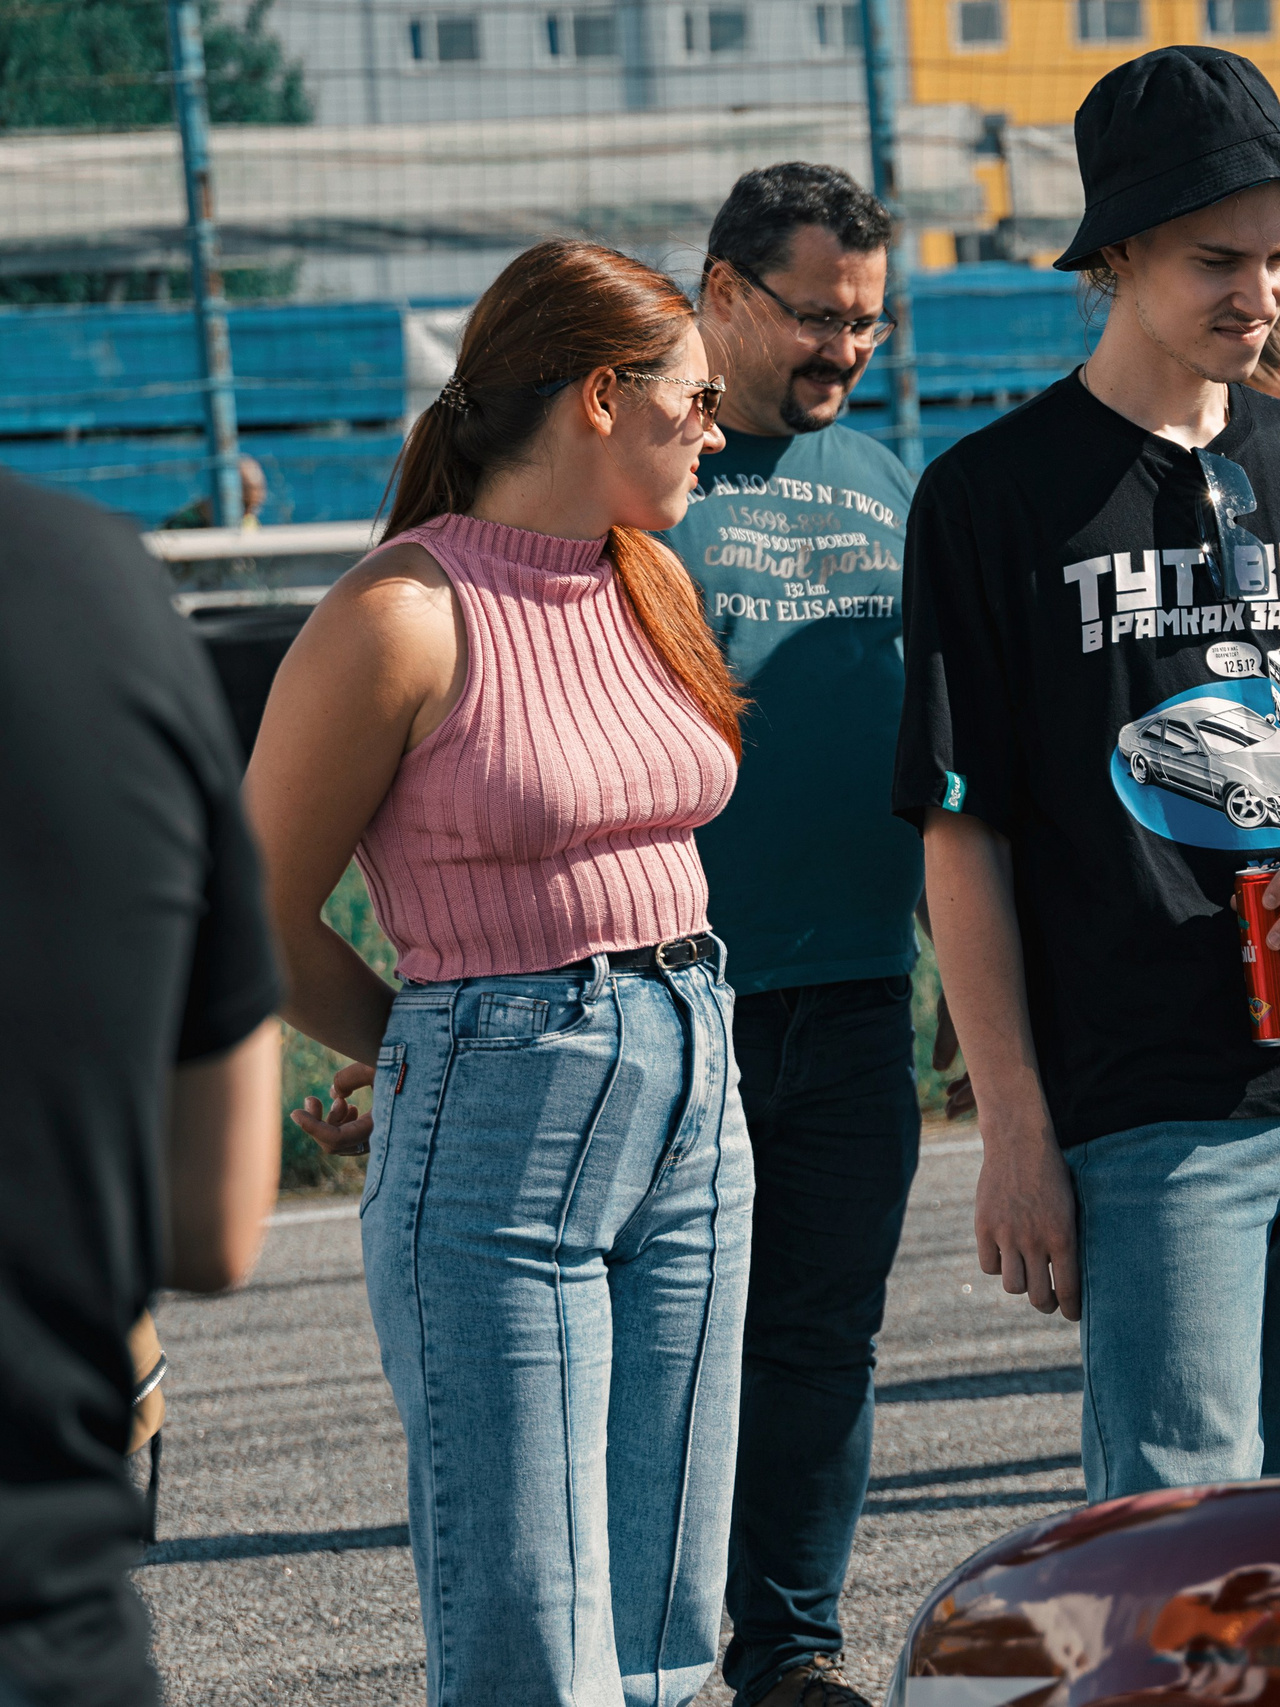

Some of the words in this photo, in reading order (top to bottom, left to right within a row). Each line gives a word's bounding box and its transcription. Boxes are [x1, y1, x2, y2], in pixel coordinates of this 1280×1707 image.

[737, 473, 813, 502] ROUTES
[718, 527, 728, 541] 3
[728, 528, 771, 550] SISTERS
[771, 535, 815, 553] SOUTH
[817, 532, 869, 550] BORDER
[704, 541, 813, 580] control
[818, 541, 902, 585] posts
[784, 582, 803, 599] 132
[806, 579, 830, 597] km.
[1063, 549, 1206, 623] ТУТ
[715, 592, 771, 621] PORT
[776, 595, 894, 622] ELISABETH
[1082, 620, 1103, 653] В
[1111, 602, 1245, 643] РАМКАХ
[1225, 658, 1255, 673] 12.5.1?
